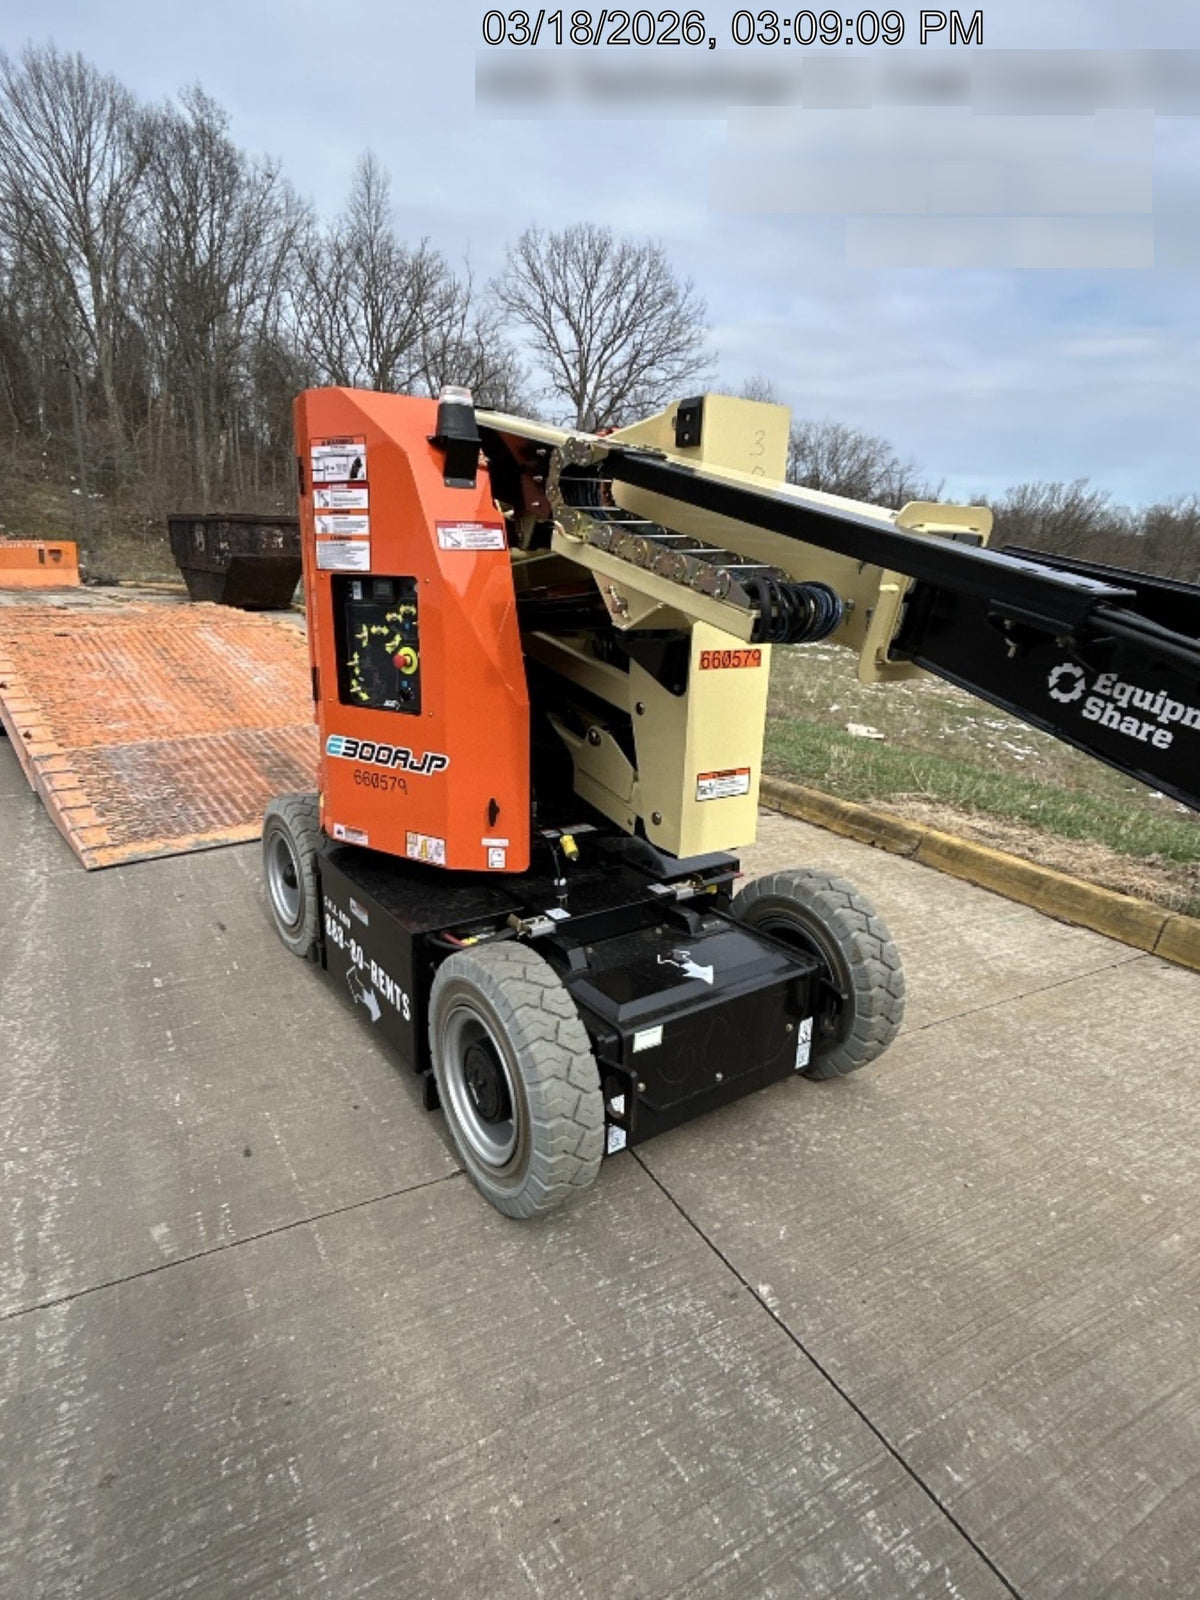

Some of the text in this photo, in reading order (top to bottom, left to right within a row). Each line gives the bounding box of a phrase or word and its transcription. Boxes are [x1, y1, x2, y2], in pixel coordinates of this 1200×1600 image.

[699, 648, 762, 669] 660579
[1081, 696, 1174, 749] Share
[327, 735, 448, 775] E300AJP
[354, 769, 408, 795] 660579
